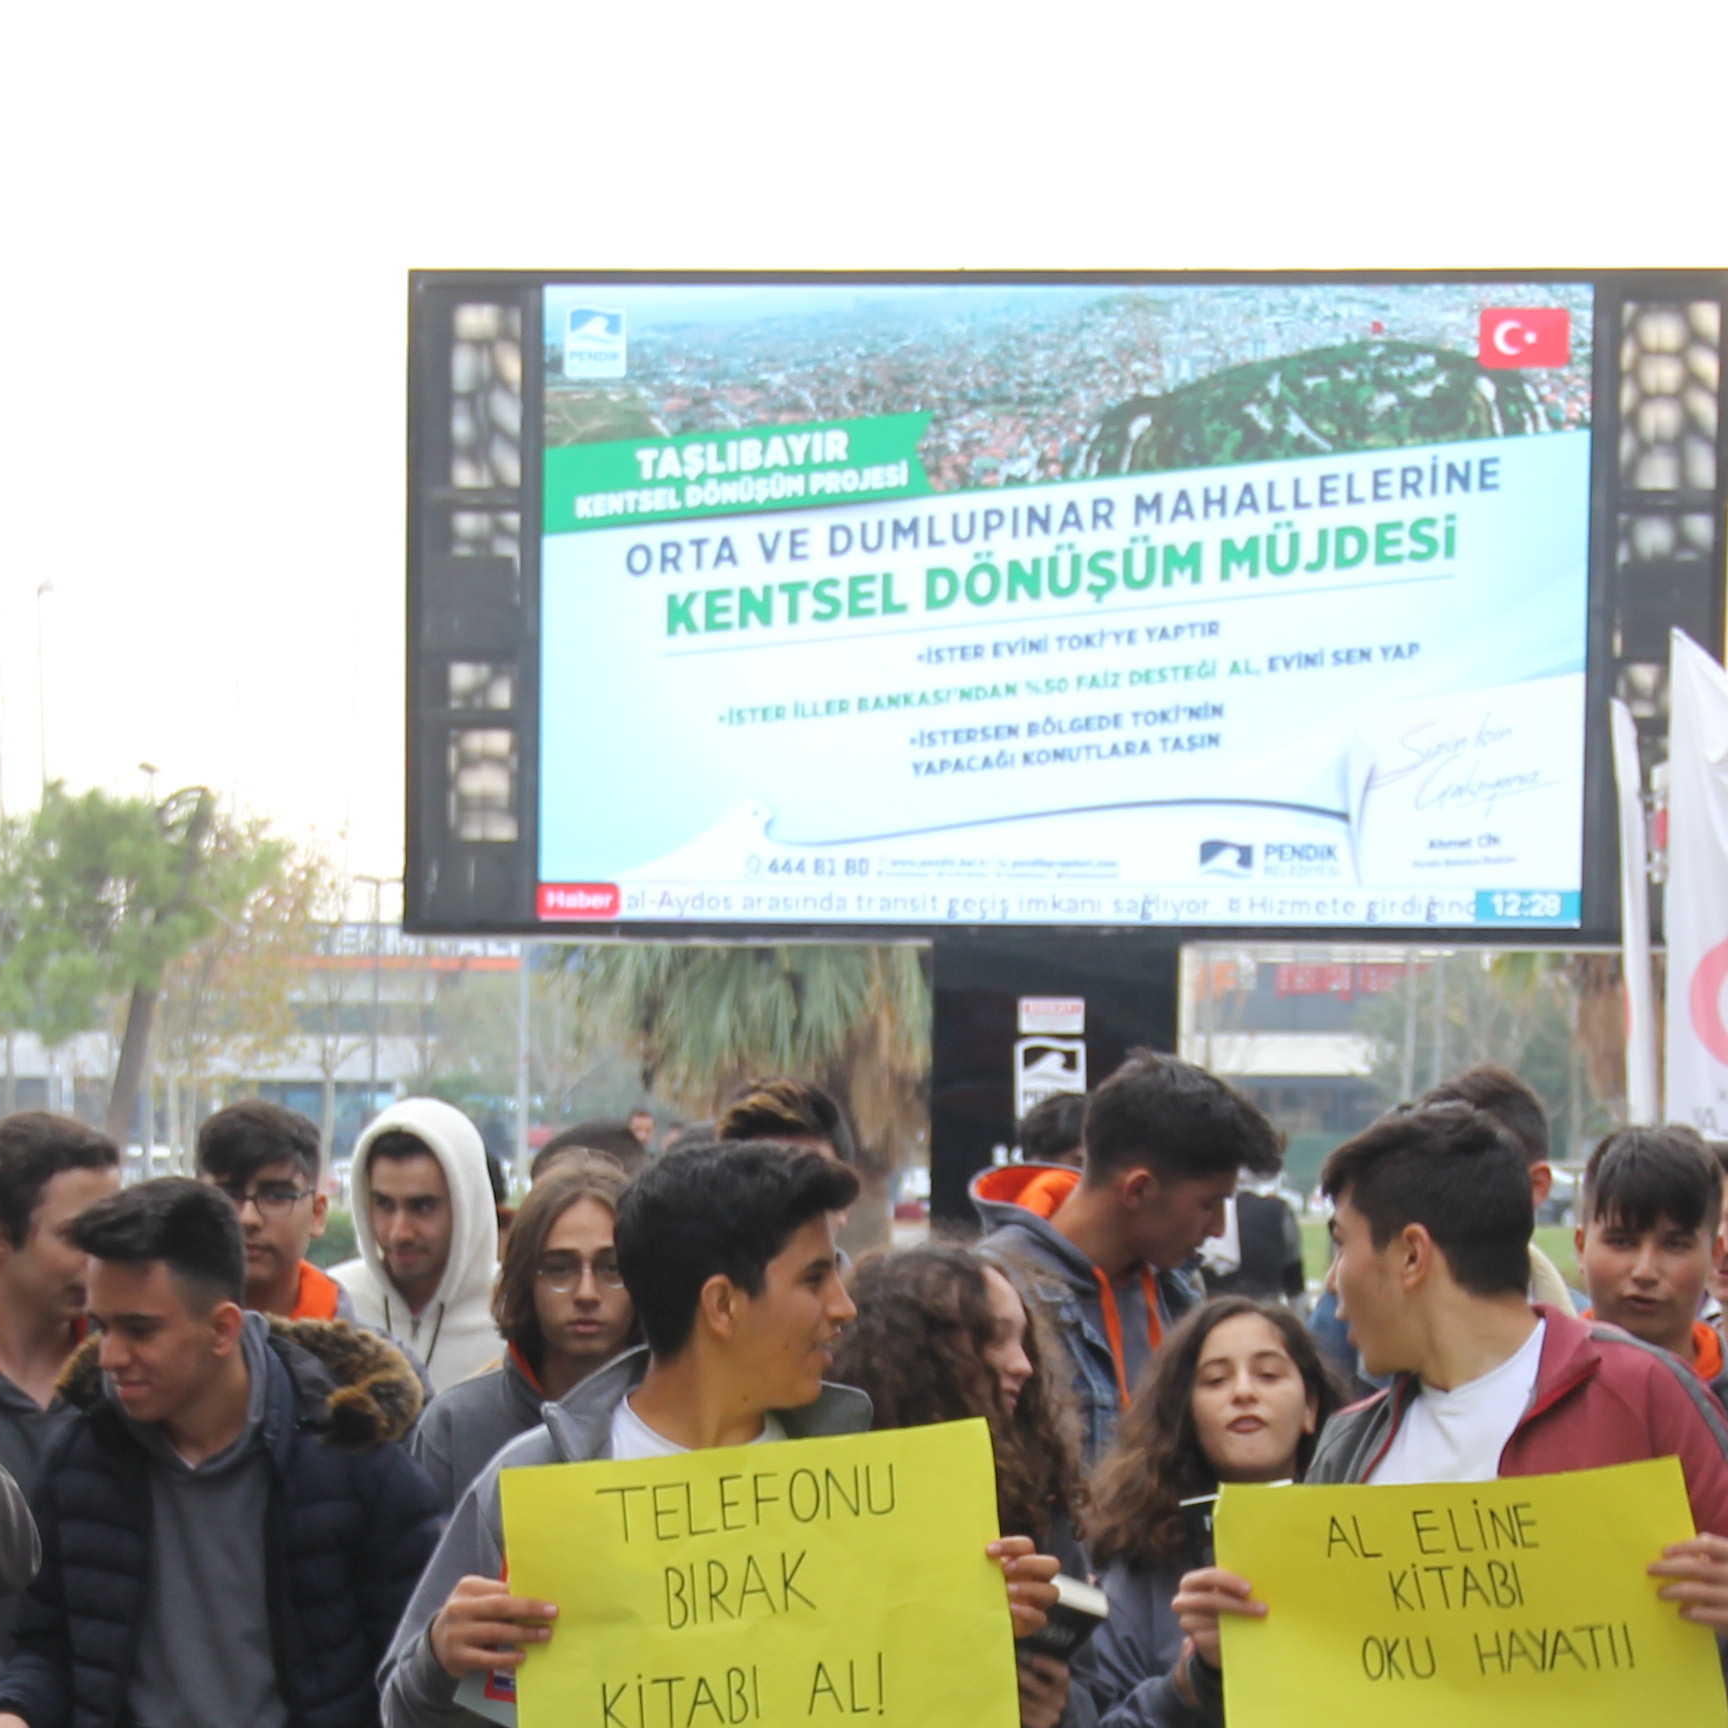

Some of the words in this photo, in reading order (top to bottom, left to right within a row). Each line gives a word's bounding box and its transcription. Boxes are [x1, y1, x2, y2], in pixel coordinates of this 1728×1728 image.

[635, 430, 850, 481] TAŞLIBAYIR
[575, 487, 681, 519] KENTSEL
[685, 473, 805, 508] DÖNÜŞÜM
[809, 459, 910, 495] PROJESİ
[626, 535, 739, 577] ORTA
[758, 528, 811, 563] VE
[829, 497, 1114, 556] DUMLUPINAR
[1133, 453, 1502, 527] MAHALLELERİNE
[666, 572, 907, 637] KENTSEL
[925, 533, 1204, 612] DÖNÜŞÜM
[1218, 512, 1458, 582] MÜJDESİ
[992, 632, 1049, 658] EVİNİ
[1145, 620, 1222, 643] YAPTIR
[793, 696, 850, 720] İLLER
[1076, 668, 1122, 693] FAİZ
[1129, 657, 1218, 688] DESTEĞİ
[1267, 648, 1325, 674] EVİNİ
[1331, 646, 1373, 667] SEN
[1379, 640, 1421, 661] YAP
[1022, 739, 1152, 768] KONUTLARA
[1159, 731, 1221, 758] TAŞIN
[767, 858, 806, 877] 444
[1264, 844, 1338, 862] PENDİK
[545, 890, 613, 909] Haber
[742, 889, 848, 912] arasında
[595, 1463, 895, 1543] TELEFONU
[1326, 1514, 1382, 1558] AL
[1412, 1499, 1540, 1554] ELİNE
[665, 1551, 816, 1629] BIRAK
[1388, 1561, 1524, 1612] KİTABI
[808, 1652, 885, 1716] AL!
[1362, 1635, 1436, 1681] OKU
